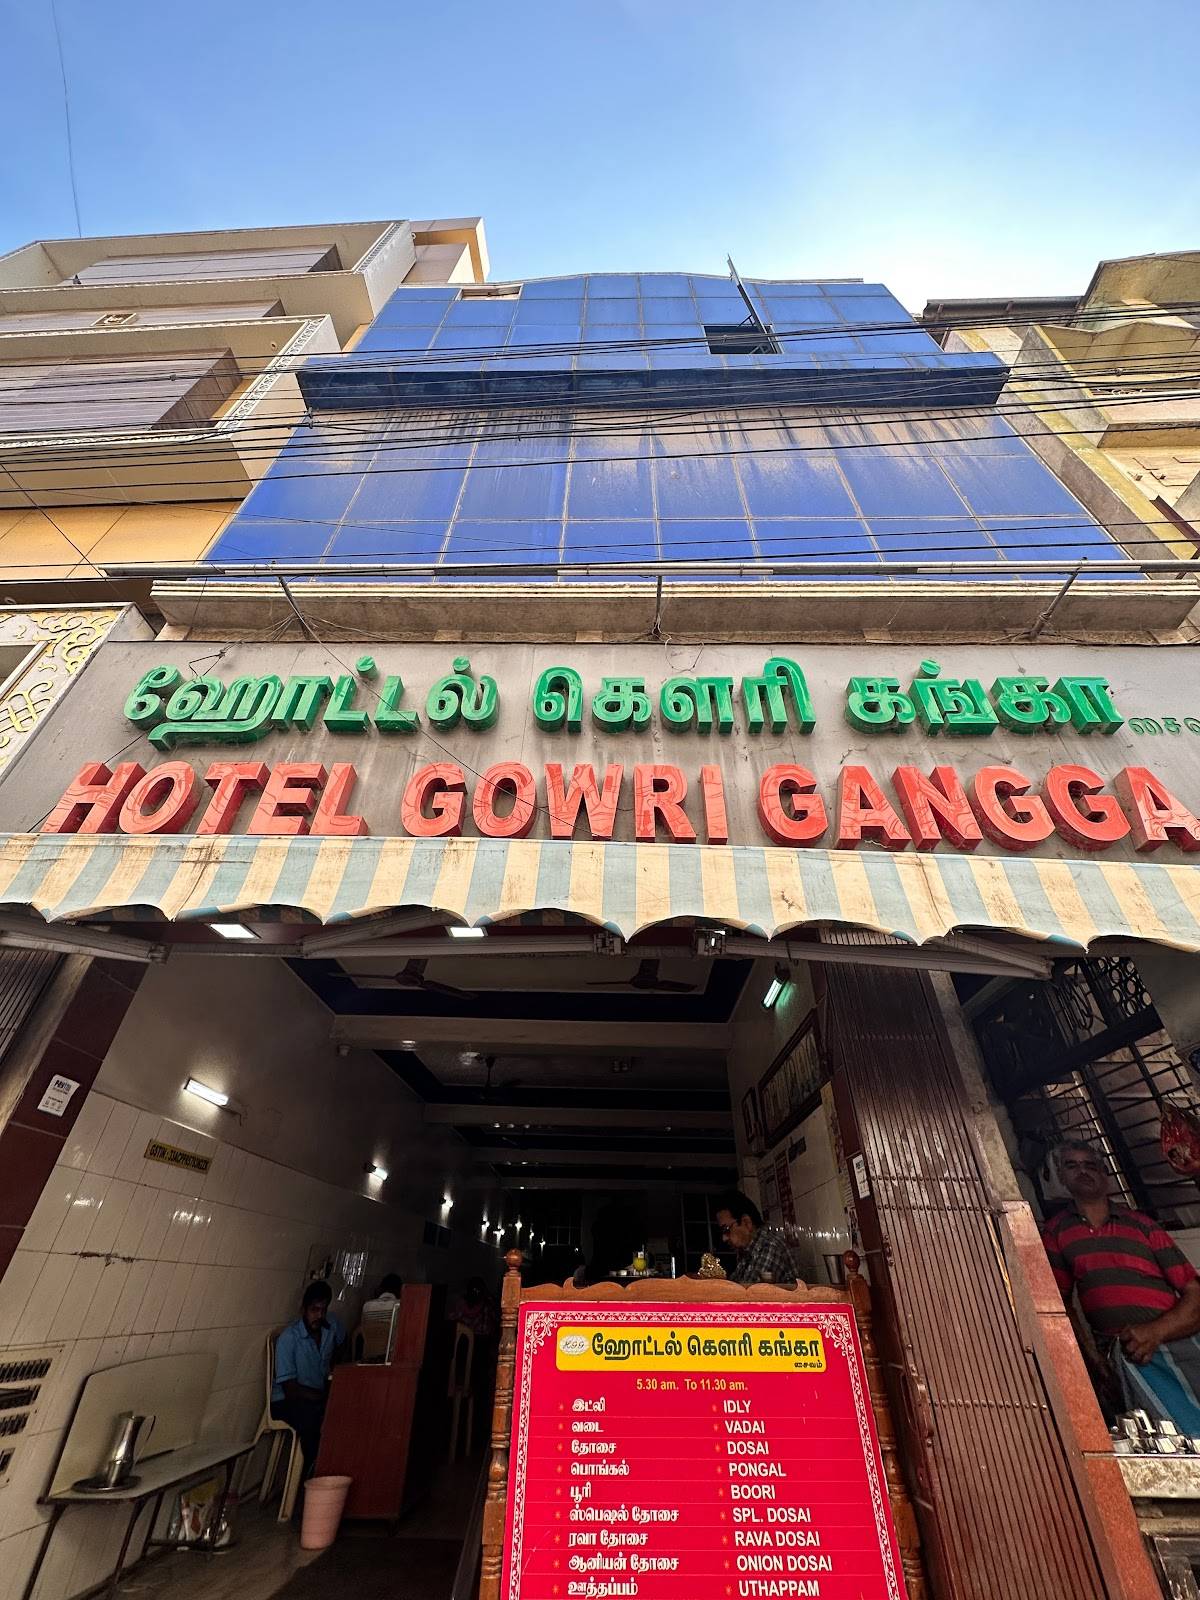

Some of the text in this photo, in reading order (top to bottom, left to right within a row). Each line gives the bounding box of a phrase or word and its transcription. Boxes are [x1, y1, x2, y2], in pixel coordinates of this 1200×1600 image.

[124, 656, 499, 750] ஹோட்டல்
[845, 659, 1125, 736] கங்கா
[41, 761, 1200, 851] HOTEL GOWRI GANGGA
[592, 1331, 682, 1360] ஹோட்டல்
[758, 1331, 820, 1357] கங்கா
[636, 1378, 748, 1390] 5.30 am. To 11.30 am.
[572, 1397, 606, 1411] இட்லி
[723, 1400, 751, 1413] IDLY
[571, 1421, 604, 1432] வடை
[725, 1420, 765, 1433] VADAI
[571, 1439, 617, 1456] தோசை
[727, 1441, 769, 1454] DOSAI
[571, 1459, 630, 1475] பொங்கல்
[729, 1463, 787, 1476] PONGAL
[570, 1481, 591, 1503] பூரி
[730, 1485, 776, 1499] BOORI
[569, 1503, 680, 1525] ஸ்பெஷல் தோசை
[732, 1507, 811, 1522] SPL. DOSAI
[568, 1529, 649, 1549] ரவா தோசை
[735, 1531, 820, 1546] RAVA DOSAI
[569, 1552, 680, 1574] ஆனியன் தோசை
[736, 1555, 832, 1571] ONION DOSAI
[568, 1576, 639, 1599] ஊத்தப்பம்
[739, 1580, 820, 1596] UTHAPPAM
